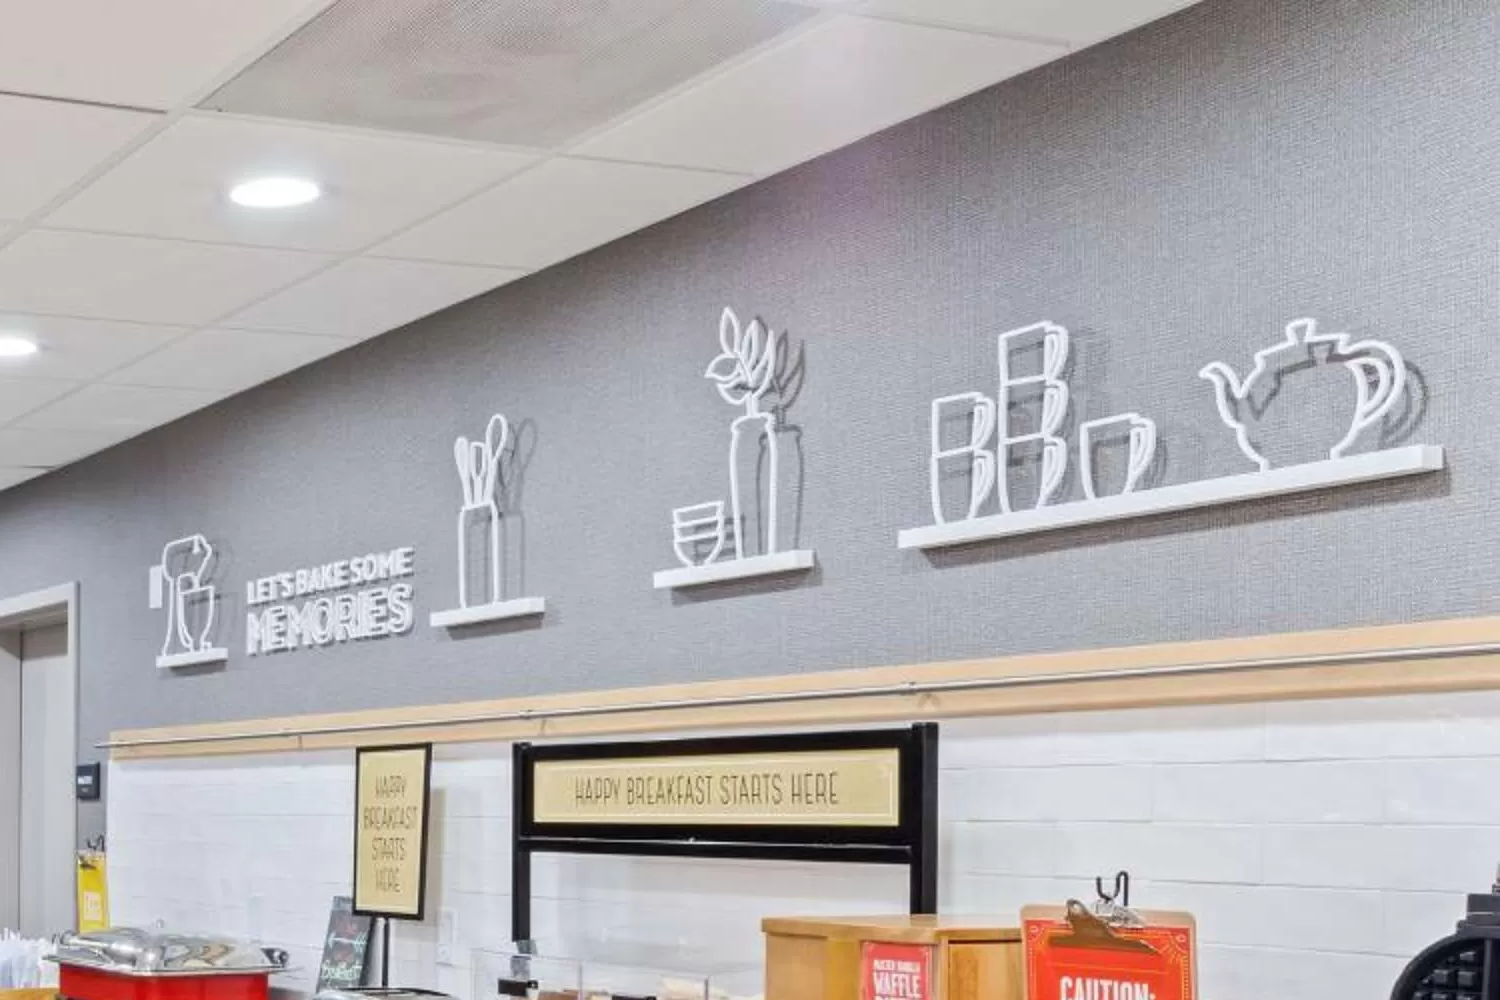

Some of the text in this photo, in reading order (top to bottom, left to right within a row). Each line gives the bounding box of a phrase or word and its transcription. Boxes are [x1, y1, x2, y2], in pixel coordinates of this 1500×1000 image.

[247, 546, 414, 606] LET'S BAKE SOME
[246, 582, 414, 656] MEMORIES
[374, 773, 407, 801] HAPPY
[574, 771, 840, 806] HAPPY BREAKFAST STARTS HERE
[362, 803, 418, 831] BREAKFAST
[371, 836, 406, 862] STARTS
[374, 866, 401, 894] HERE
[873, 971, 921, 999] WAFFLE
